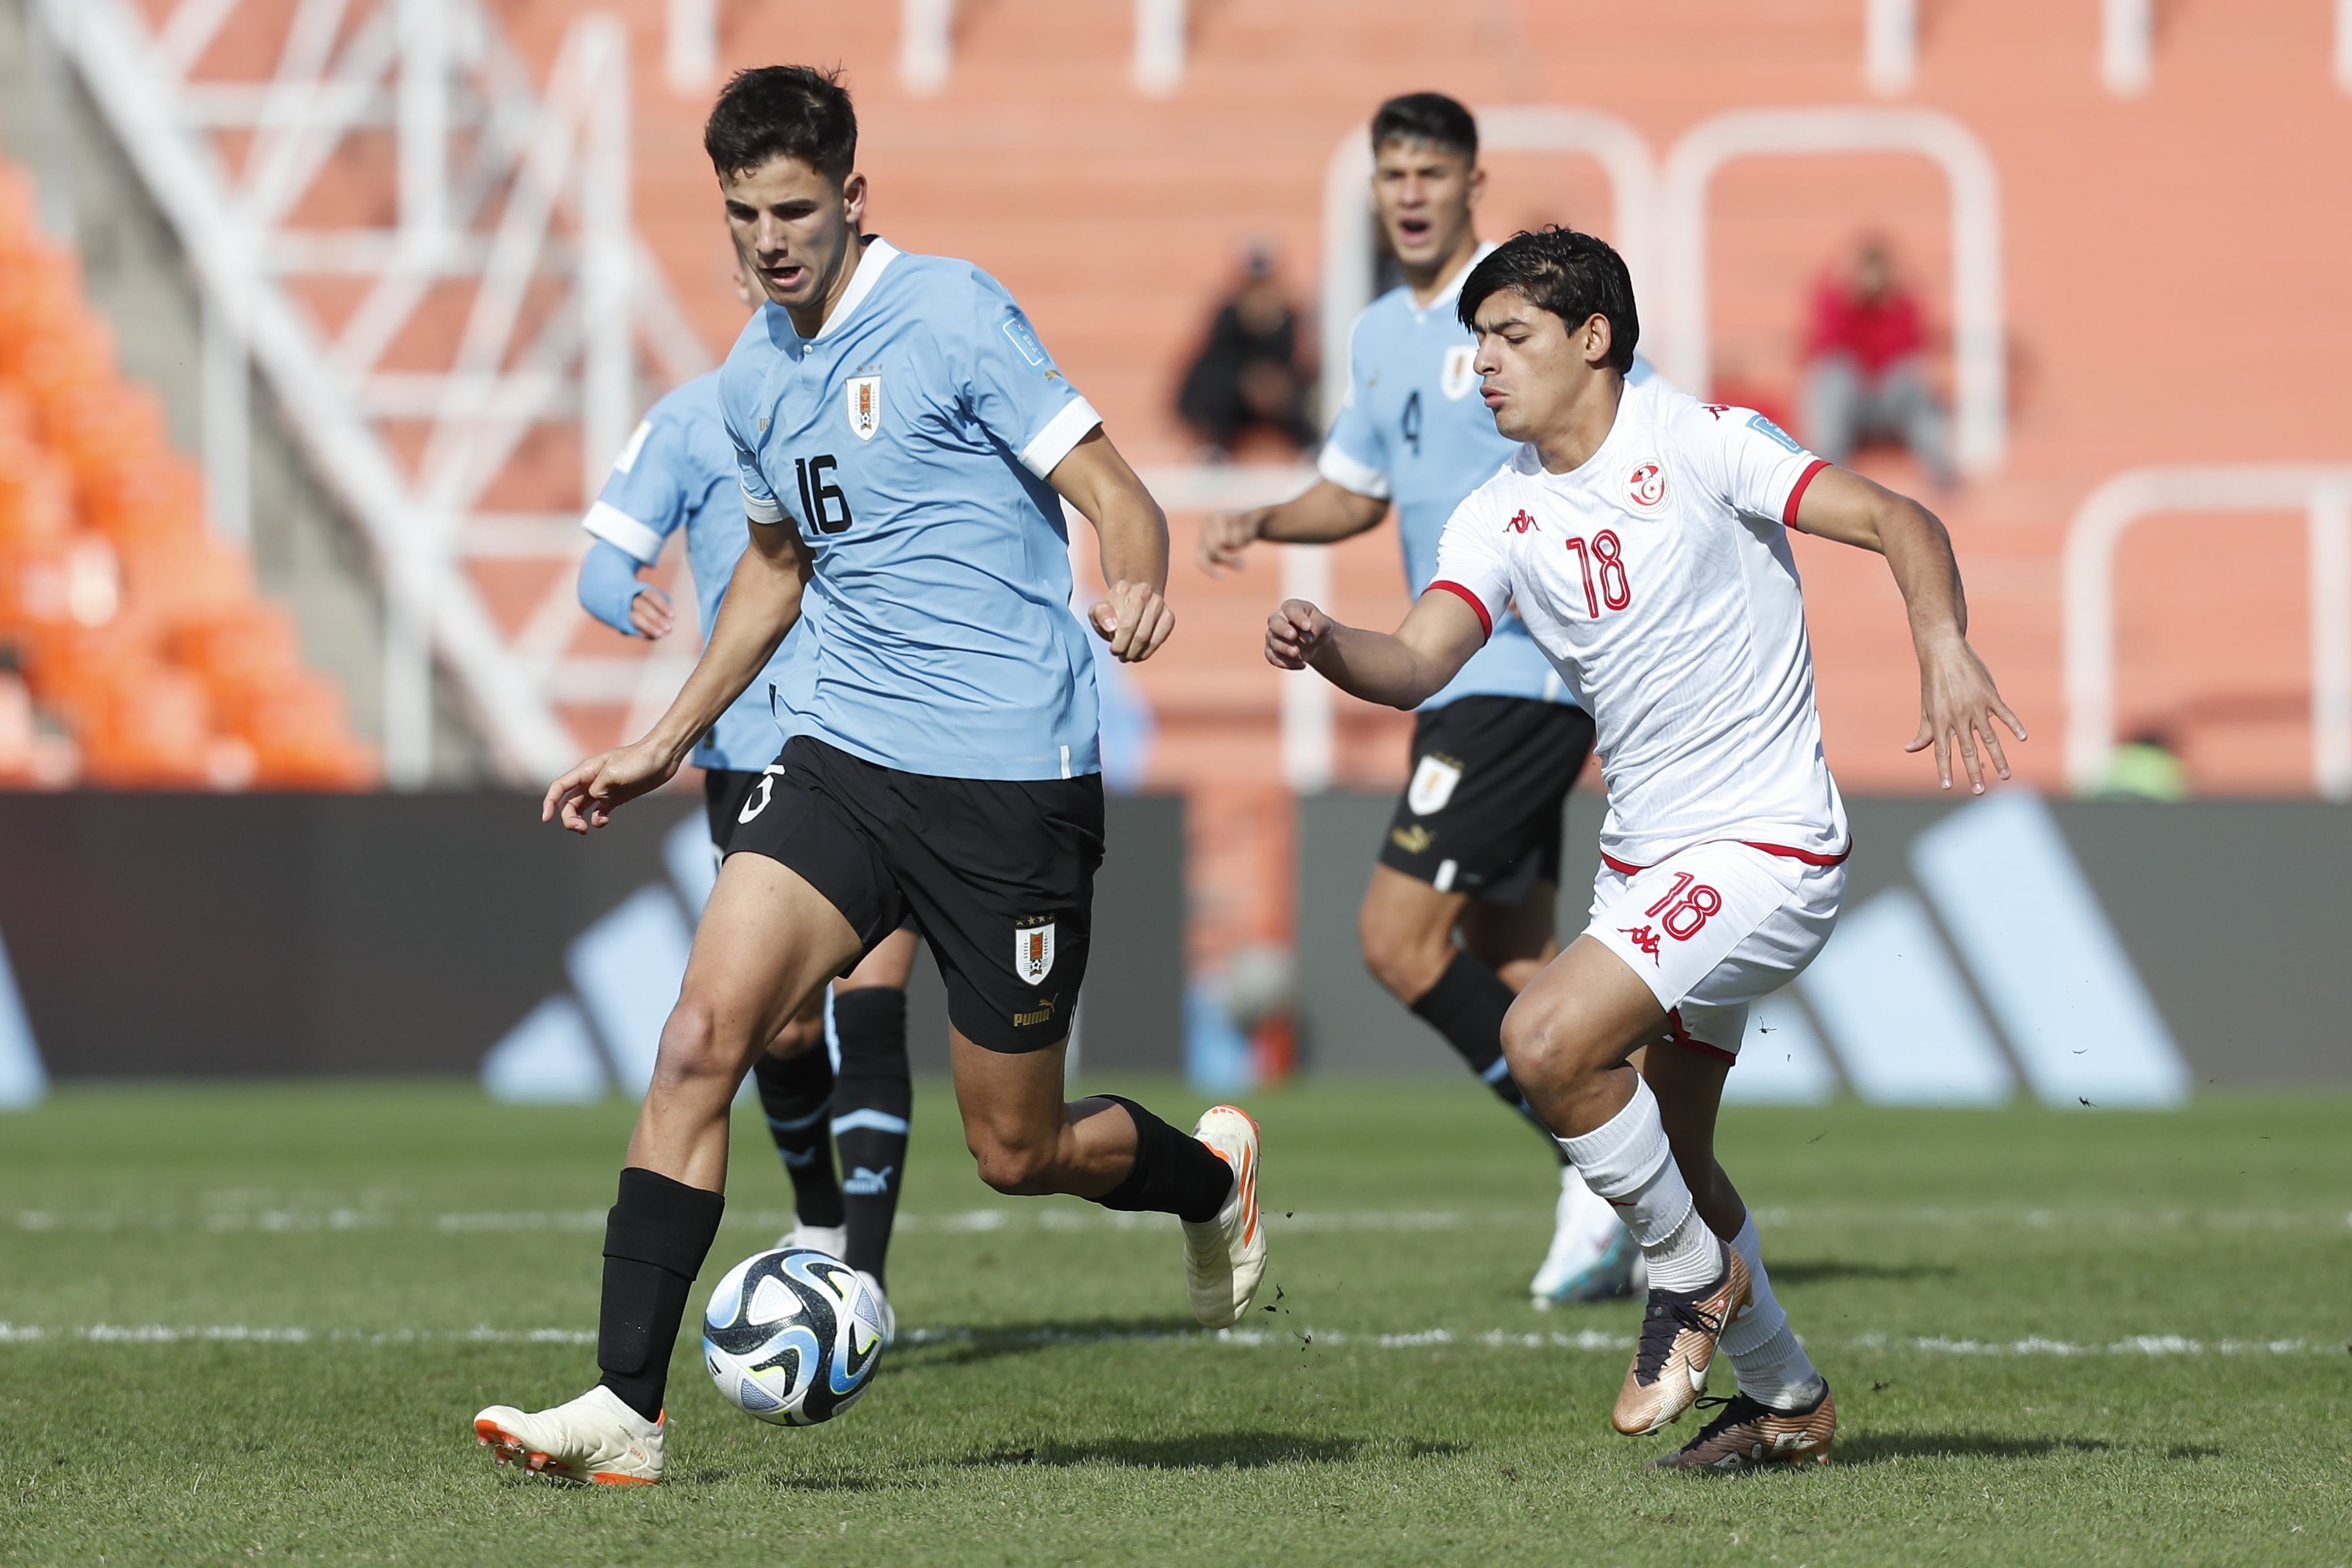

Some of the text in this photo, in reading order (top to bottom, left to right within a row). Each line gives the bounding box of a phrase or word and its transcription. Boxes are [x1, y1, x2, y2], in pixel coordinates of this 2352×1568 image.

[1402, 389, 1422, 456] 4
[795, 454, 853, 535] 16
[1566, 529, 1631, 619] 18
[1645, 872, 1722, 941] 18
[1014, 1007, 1051, 1027] PUMA
